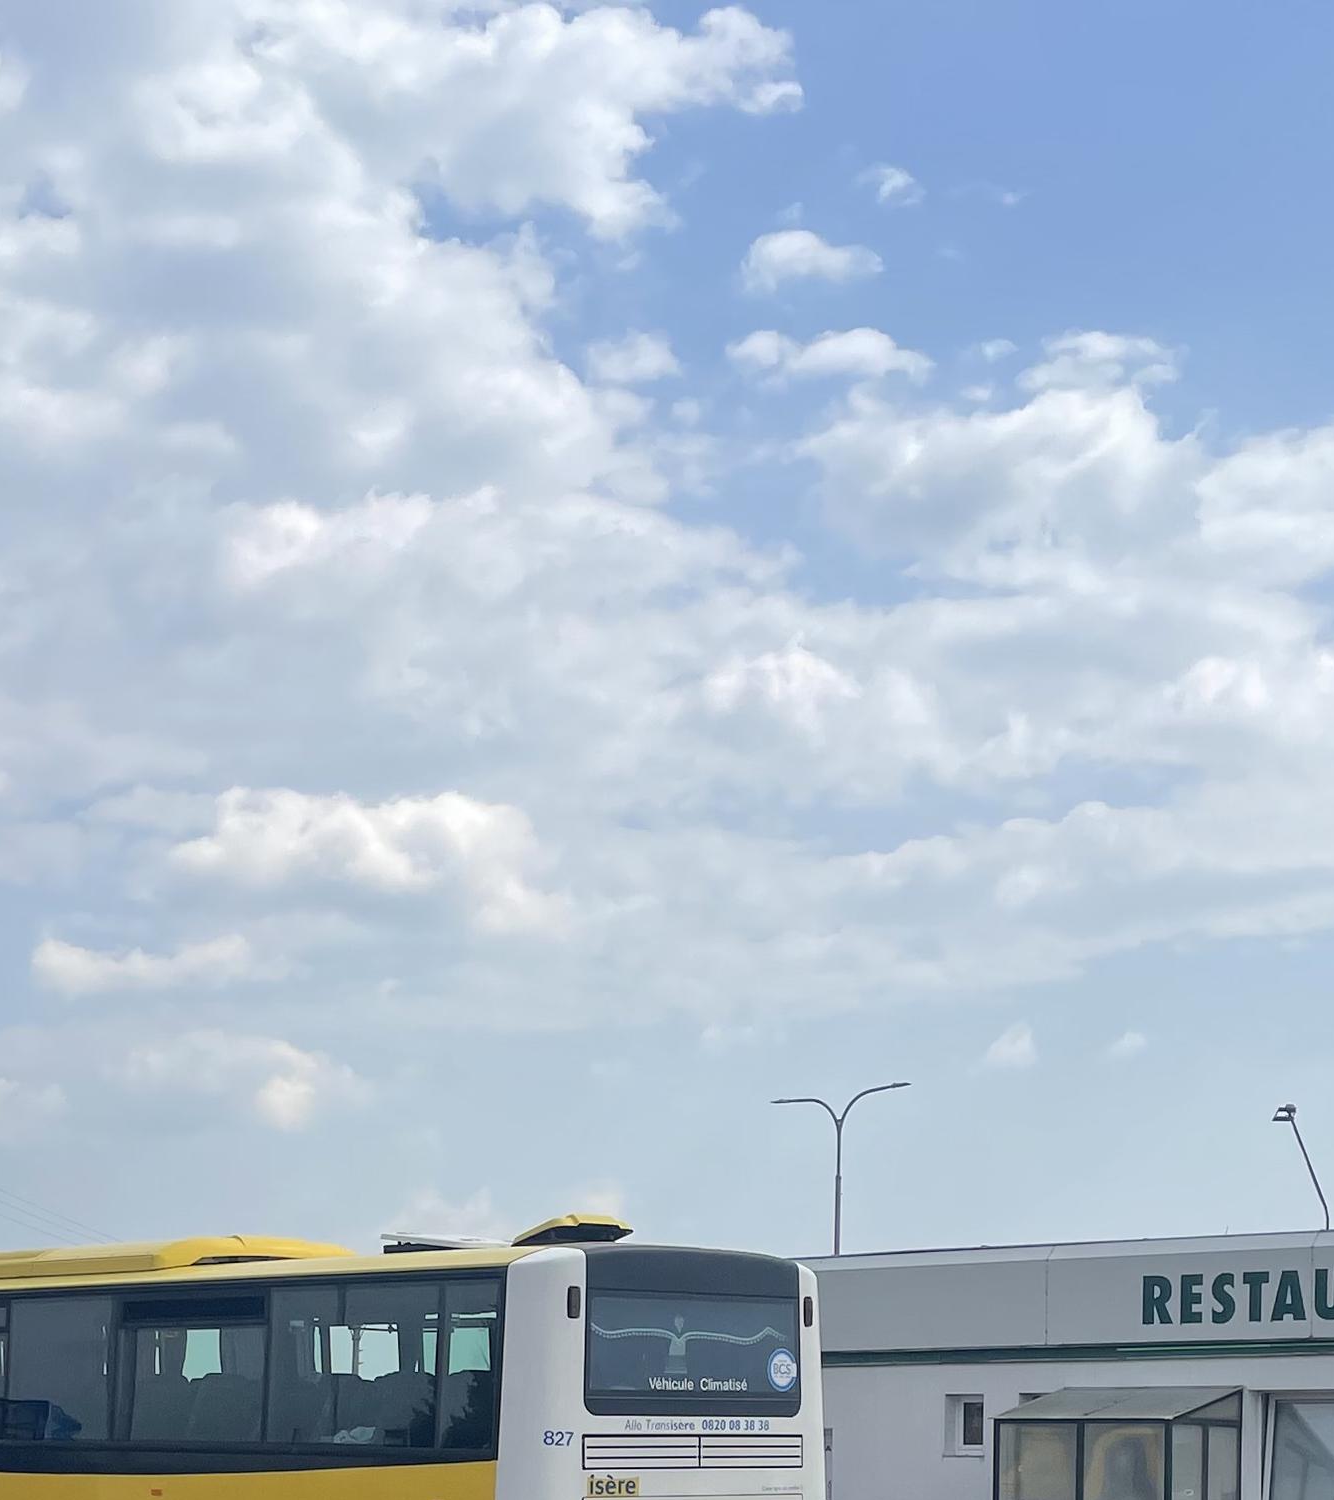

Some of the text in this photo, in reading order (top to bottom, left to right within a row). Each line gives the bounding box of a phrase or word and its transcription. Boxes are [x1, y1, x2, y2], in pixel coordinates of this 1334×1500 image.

[773, 1363, 792, 1375] BCS
[649, 1376, 748, 1391] Véhicule Climatisé
[624, 1419, 642, 1431] Allo
[701, 1419, 726, 1431] 0820
[728, 1419, 741, 1431] 08
[743, 1419, 756, 1431] 38
[758, 1419, 770, 1430] 38
[543, 1430, 574, 1446] 827
[589, 1474, 637, 1495] isère
